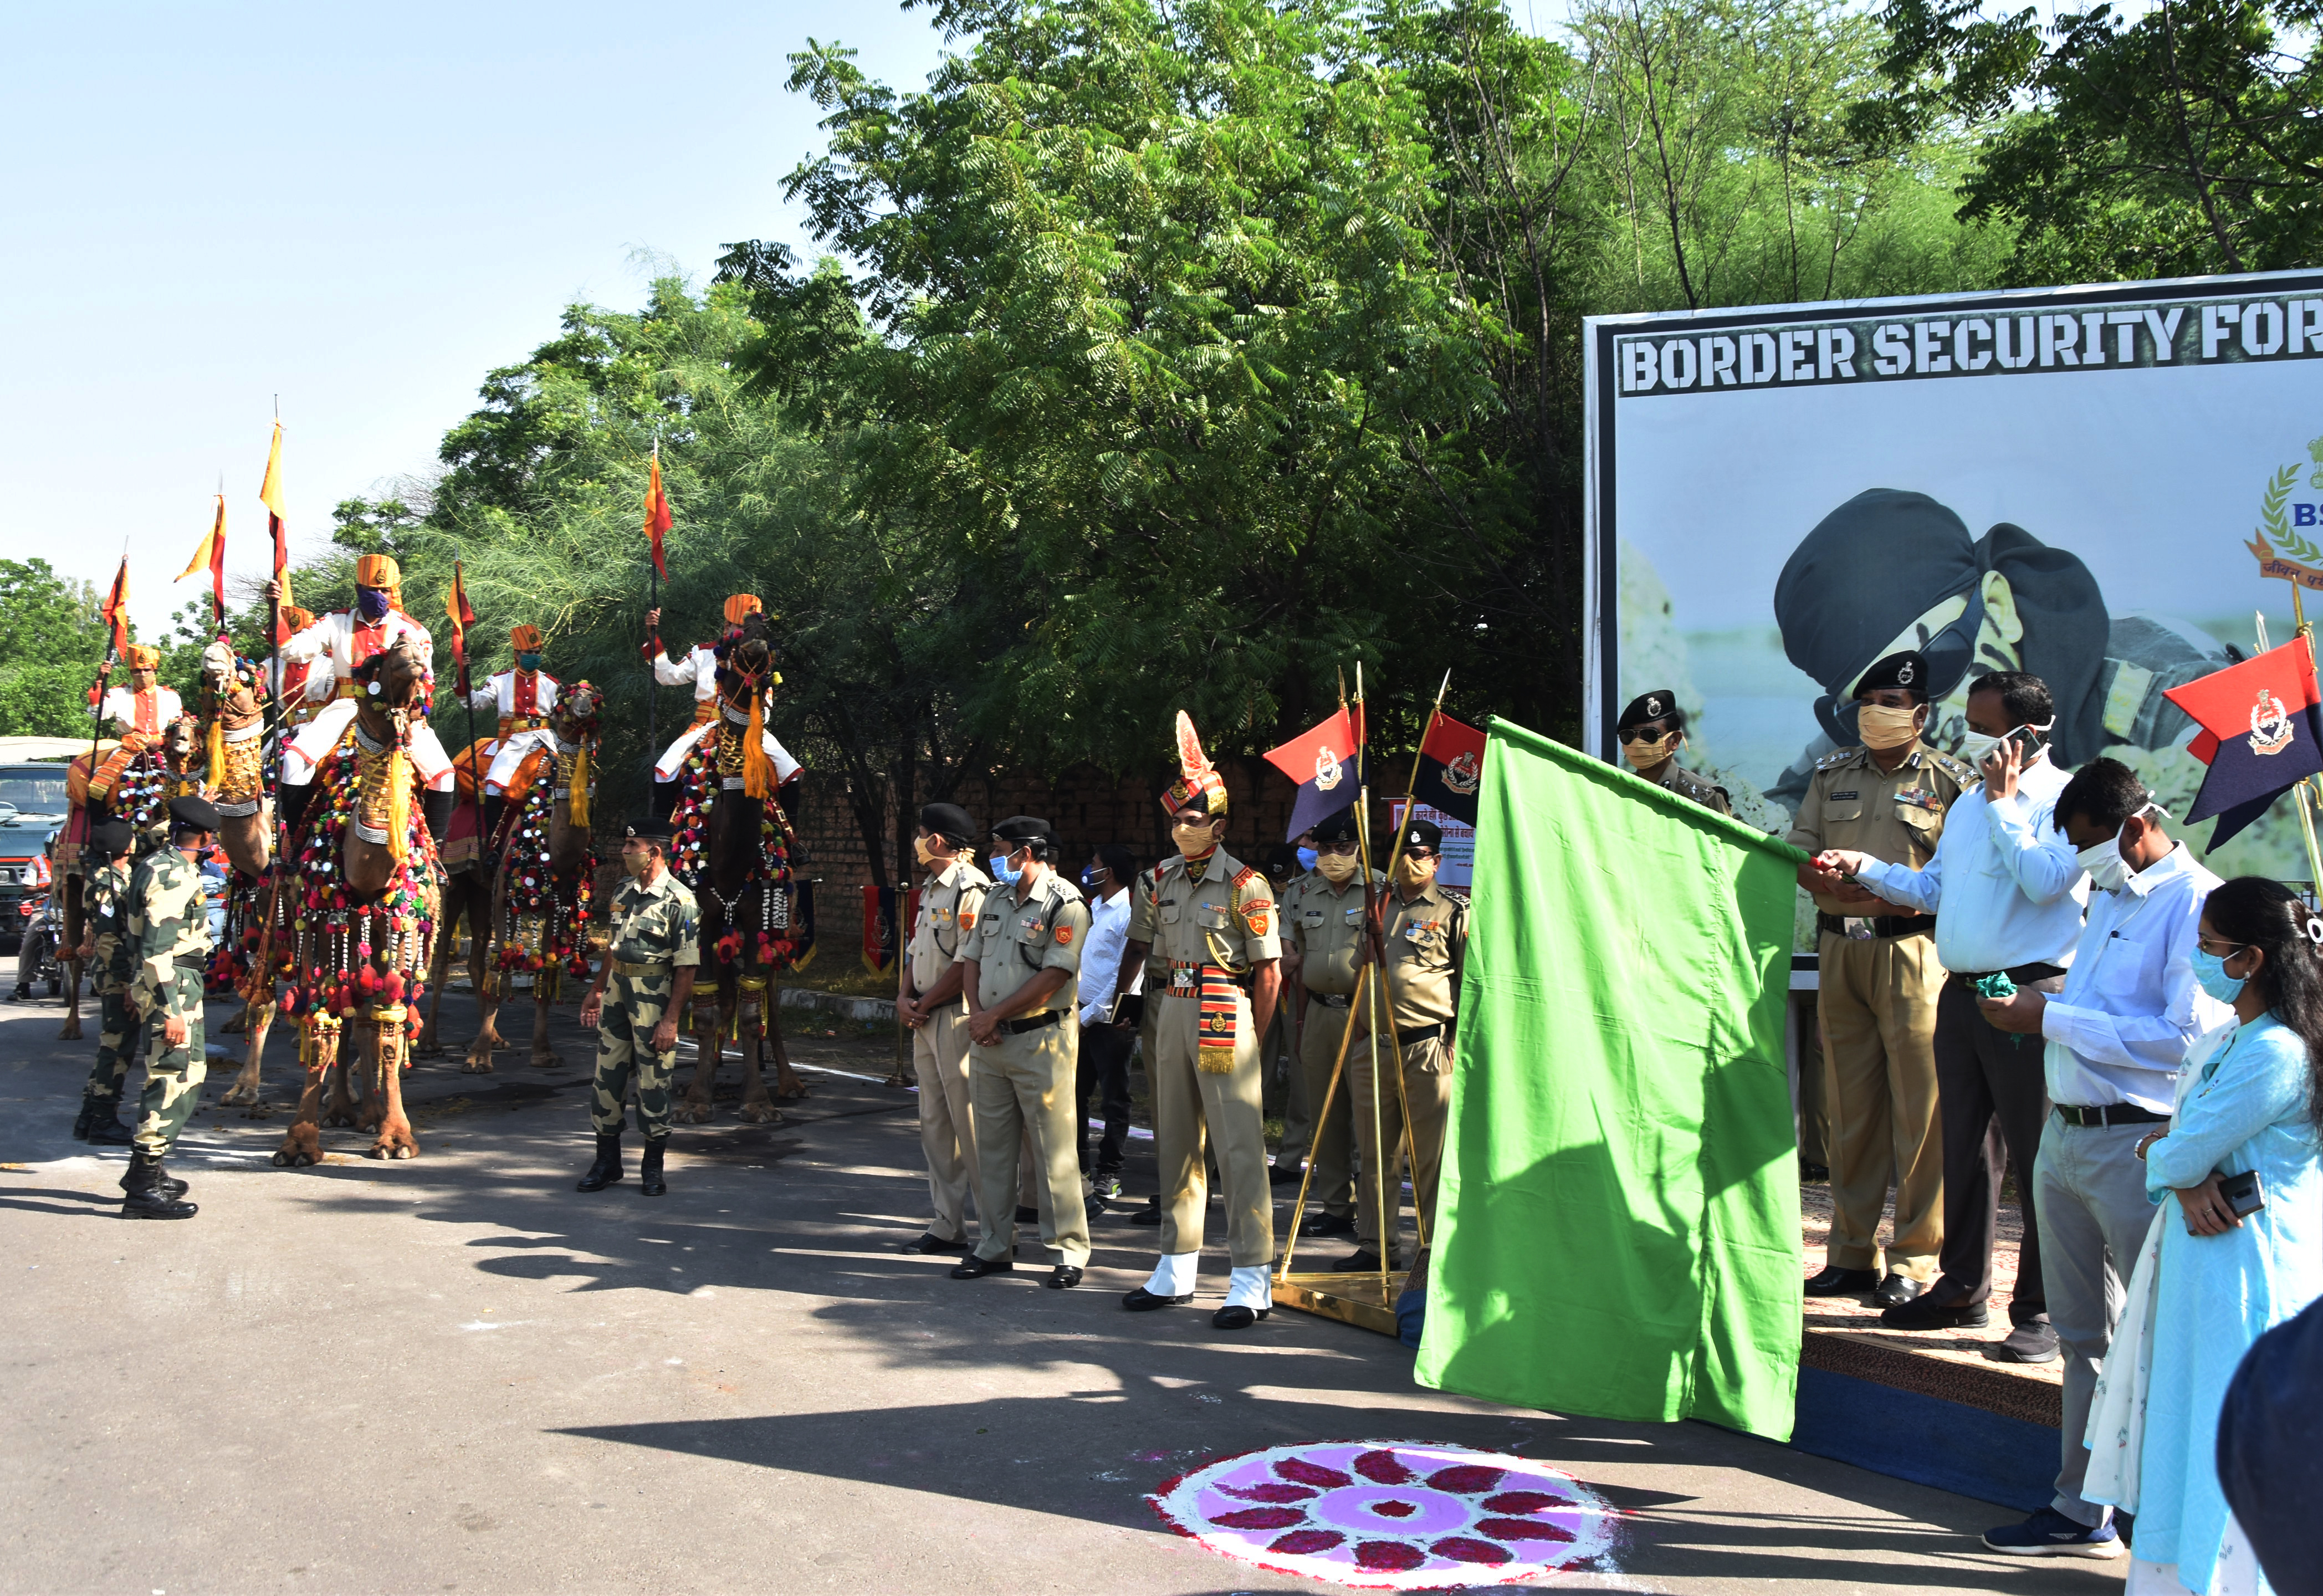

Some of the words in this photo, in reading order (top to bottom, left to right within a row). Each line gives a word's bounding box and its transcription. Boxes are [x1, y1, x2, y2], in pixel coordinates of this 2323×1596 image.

[1623, 328, 1856, 391] BORDER
[1873, 308, 2184, 376] SECURITY
[2202, 299, 2323, 358] FOR
[2292, 503, 2323, 526] B
